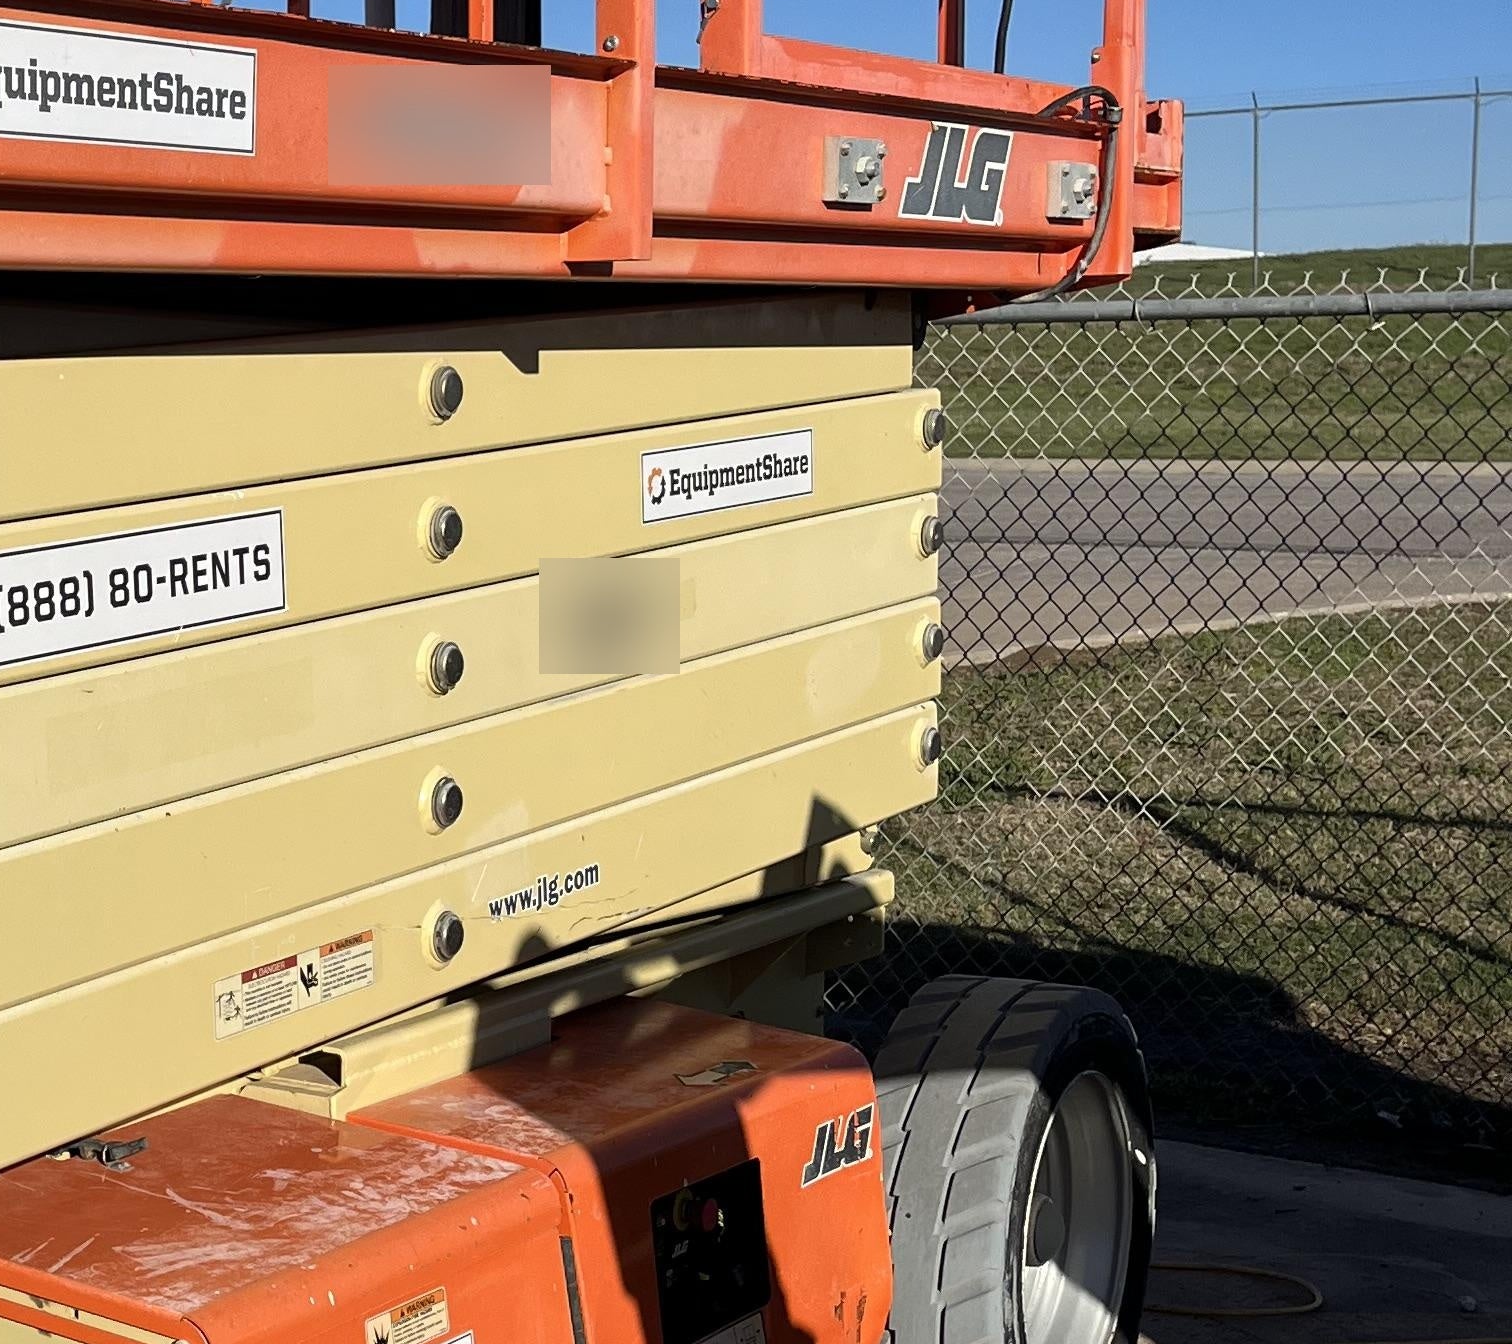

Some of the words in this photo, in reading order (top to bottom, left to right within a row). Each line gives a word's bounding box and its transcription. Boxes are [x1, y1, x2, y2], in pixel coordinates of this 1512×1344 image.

[898, 121, 1013, 226] JLG
[669, 453, 809, 500] EquipmentShare
[109, 543, 271, 608] 80-RENTS
[488, 862, 600, 920] www.jlg.com
[258, 960, 286, 977] DANGER
[801, 1102, 875, 1189] JLG
